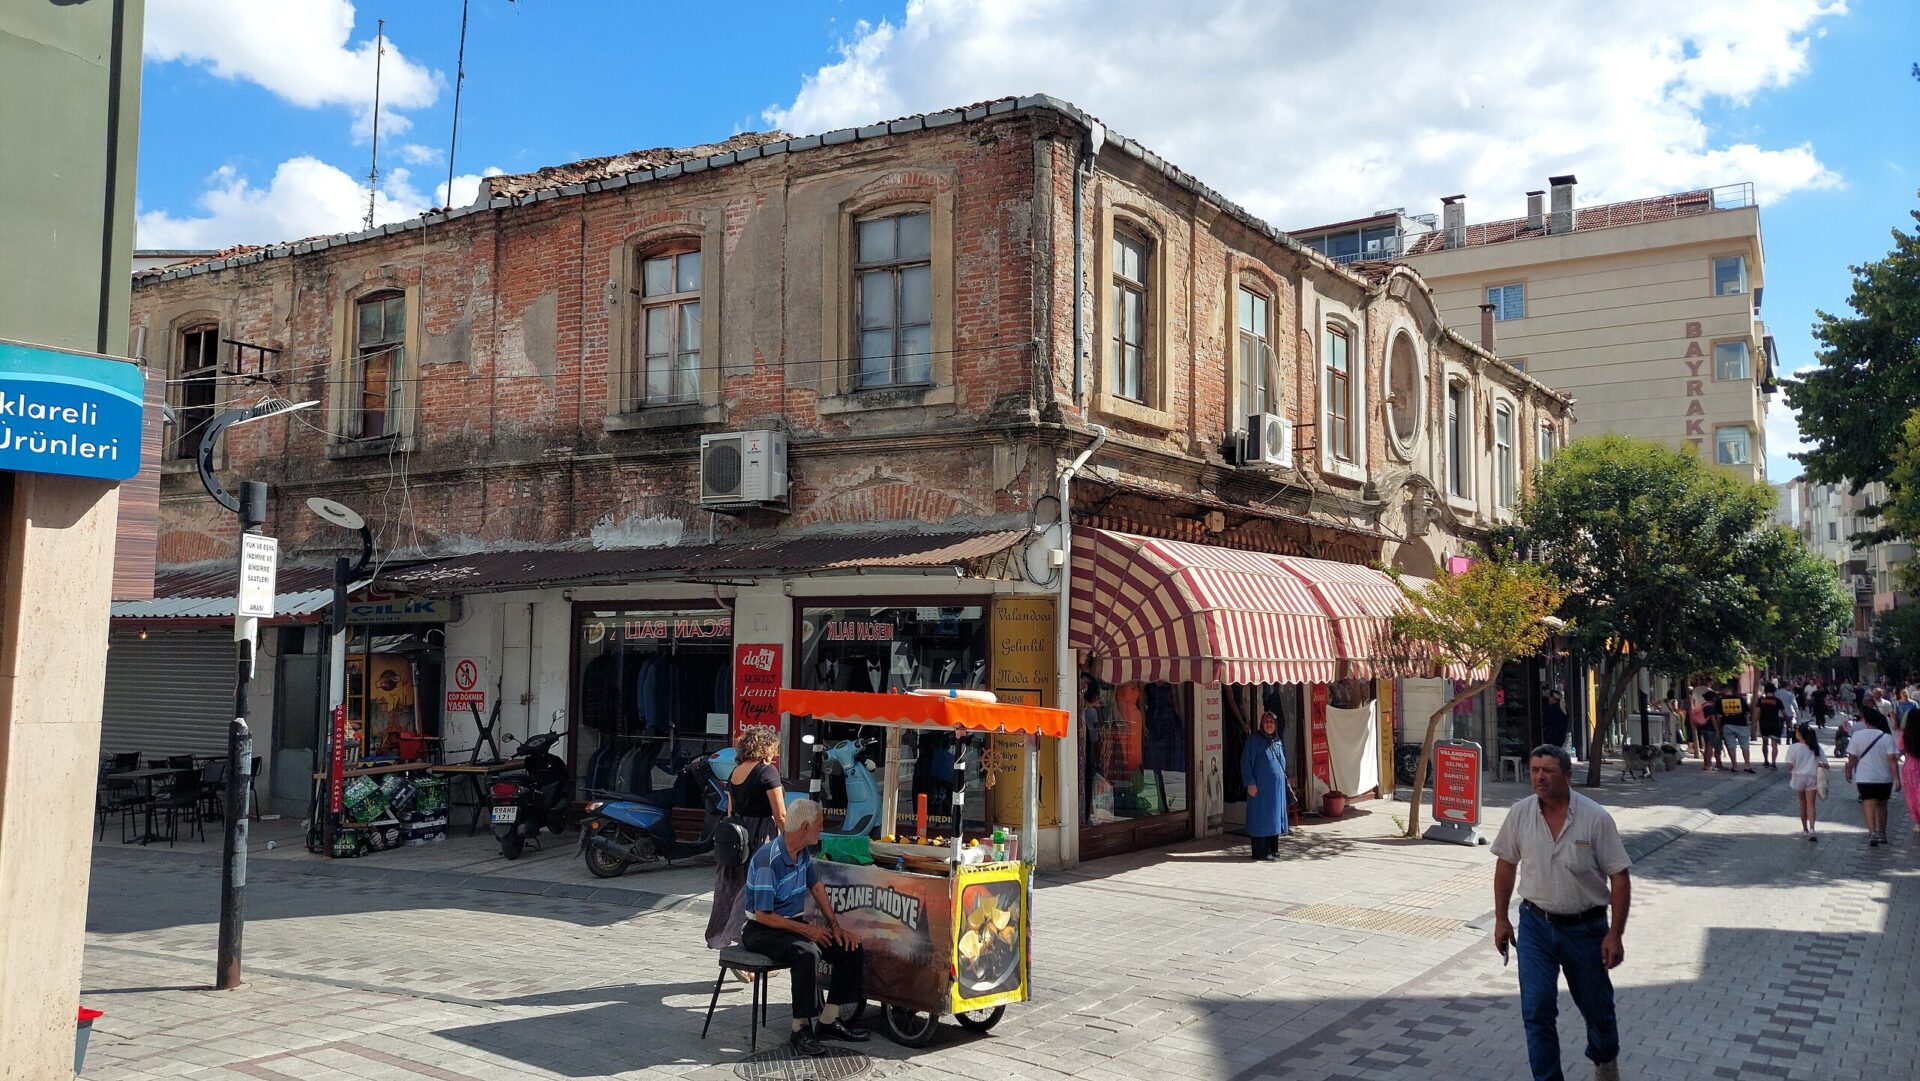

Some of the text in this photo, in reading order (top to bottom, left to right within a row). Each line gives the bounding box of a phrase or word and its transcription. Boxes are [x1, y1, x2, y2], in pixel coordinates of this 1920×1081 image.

[0, 391, 97, 426] klareli
[997, 607, 1052, 622] Valandova
[997, 668, 1029, 684] Moda
[740, 686, 777, 698] Jenni
[877, 888, 919, 931] MİDYE
